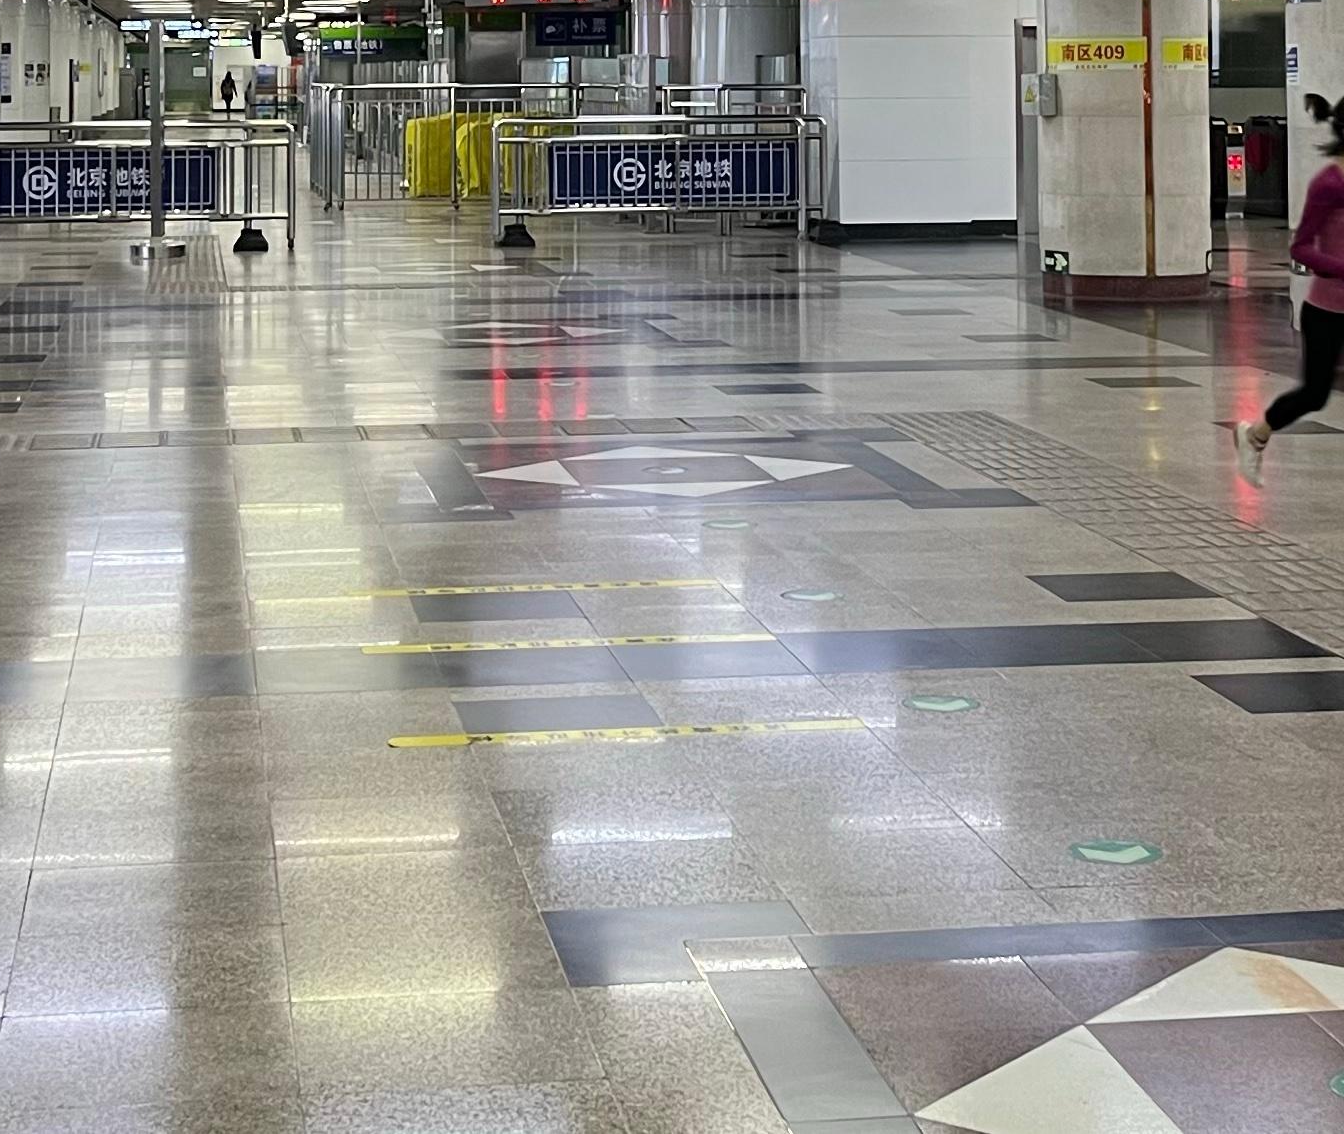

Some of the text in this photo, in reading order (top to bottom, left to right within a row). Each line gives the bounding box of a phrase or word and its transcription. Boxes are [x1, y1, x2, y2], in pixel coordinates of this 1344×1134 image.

[1061, 44, 1125, 62] 南区409
[1182, 44, 1208, 62] 南区
[66, 167, 150, 187] 北京地铁
[654, 159, 731, 178] 北京地铁
